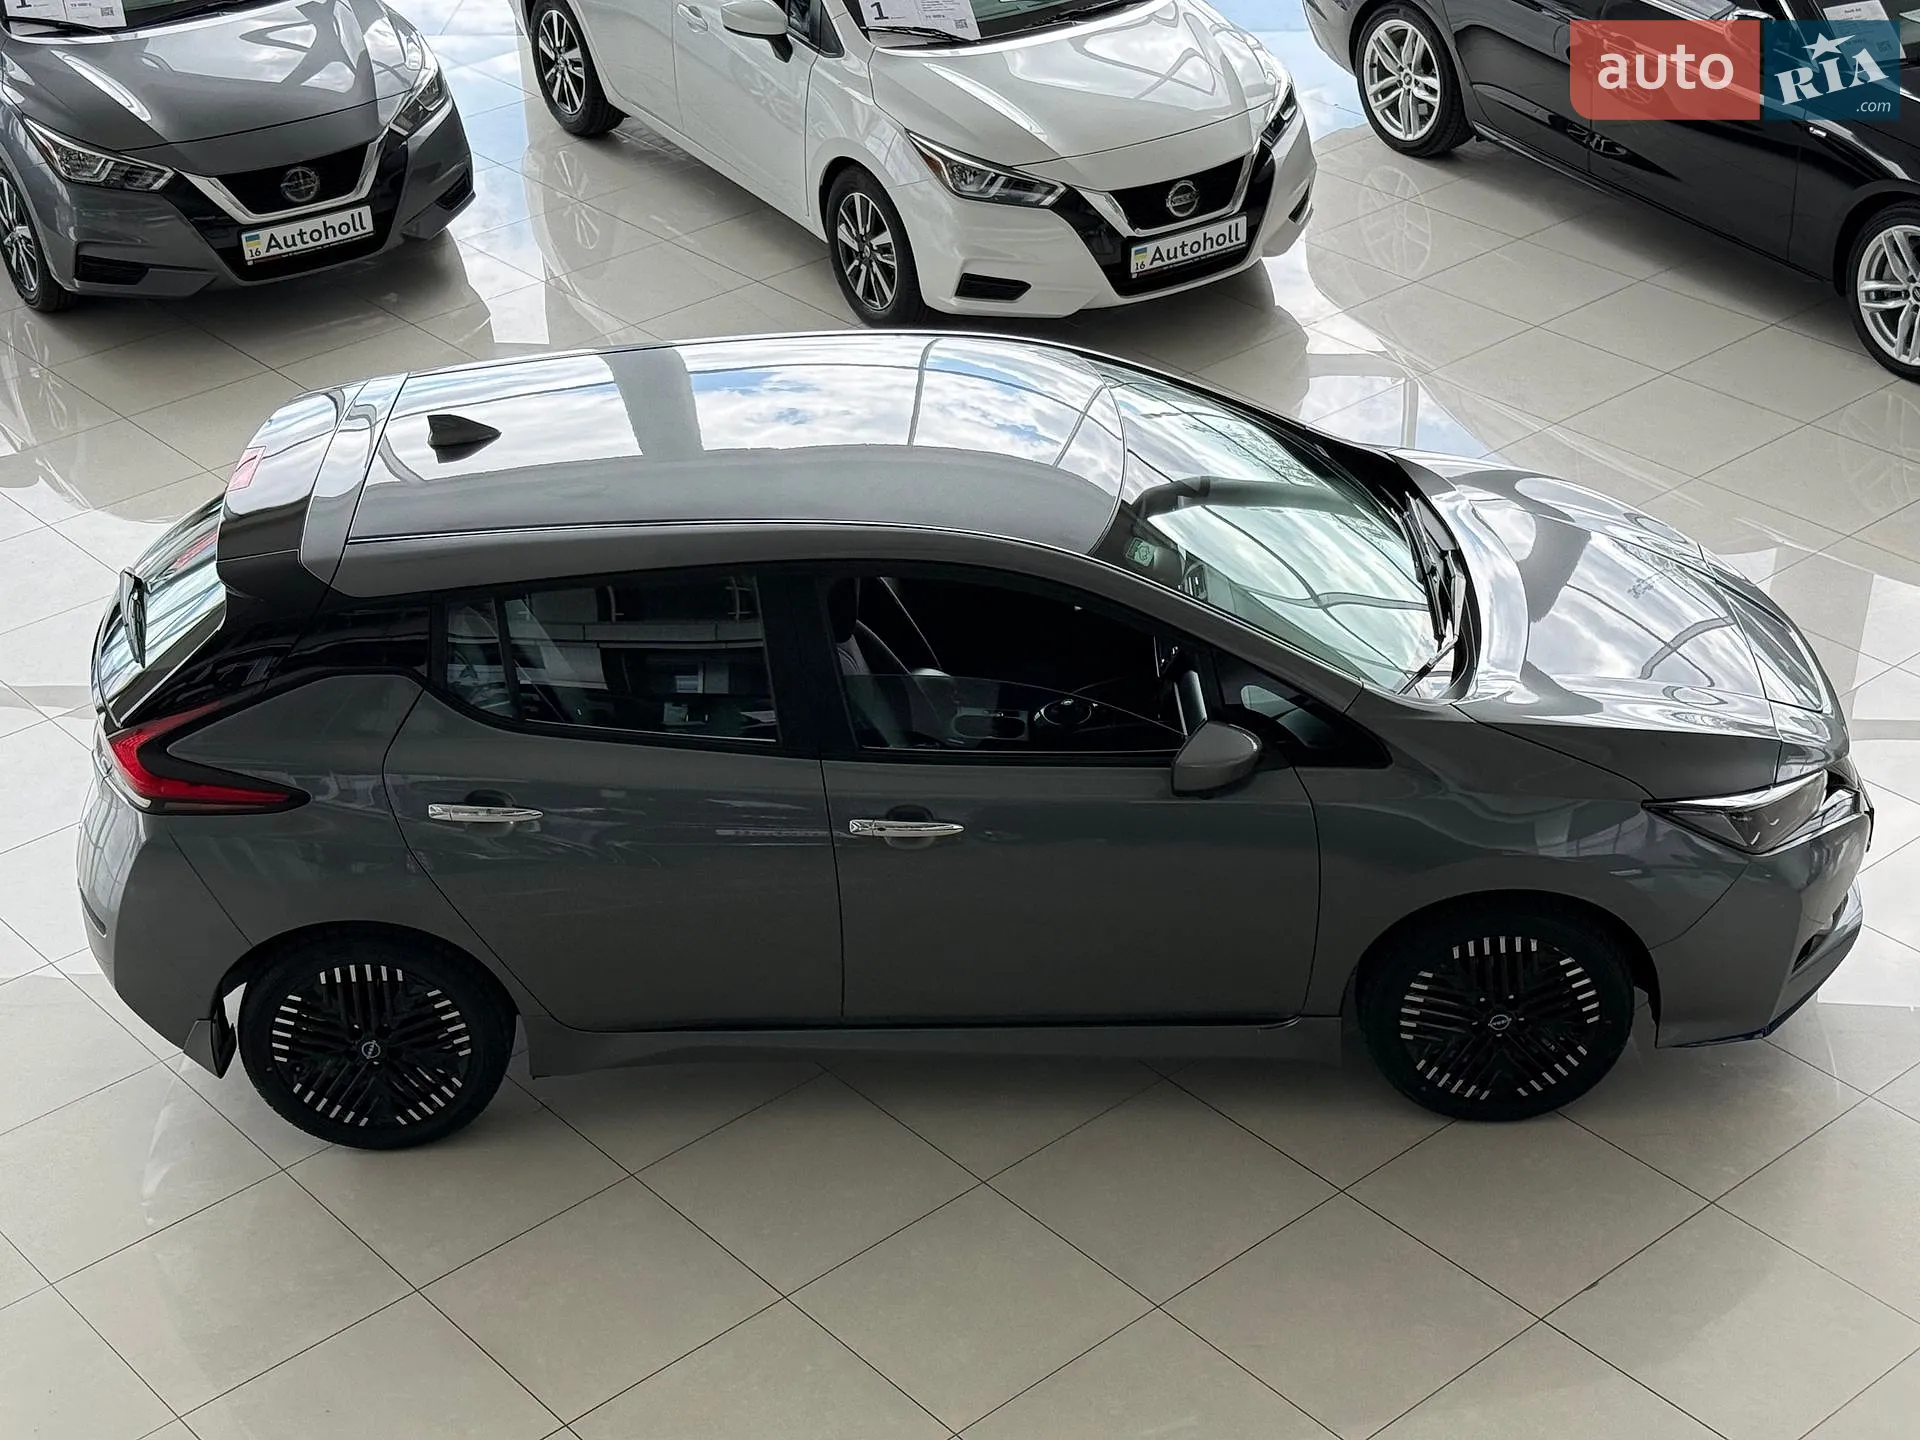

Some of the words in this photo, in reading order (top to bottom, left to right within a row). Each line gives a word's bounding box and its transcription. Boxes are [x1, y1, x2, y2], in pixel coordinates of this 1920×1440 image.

[871, 1, 889, 20] 1
[265, 211, 367, 253] Autoholl
[249, 247, 262, 258] 16
[1149, 222, 1241, 266] Autoholl
[1135, 261, 1146, 271] 16
